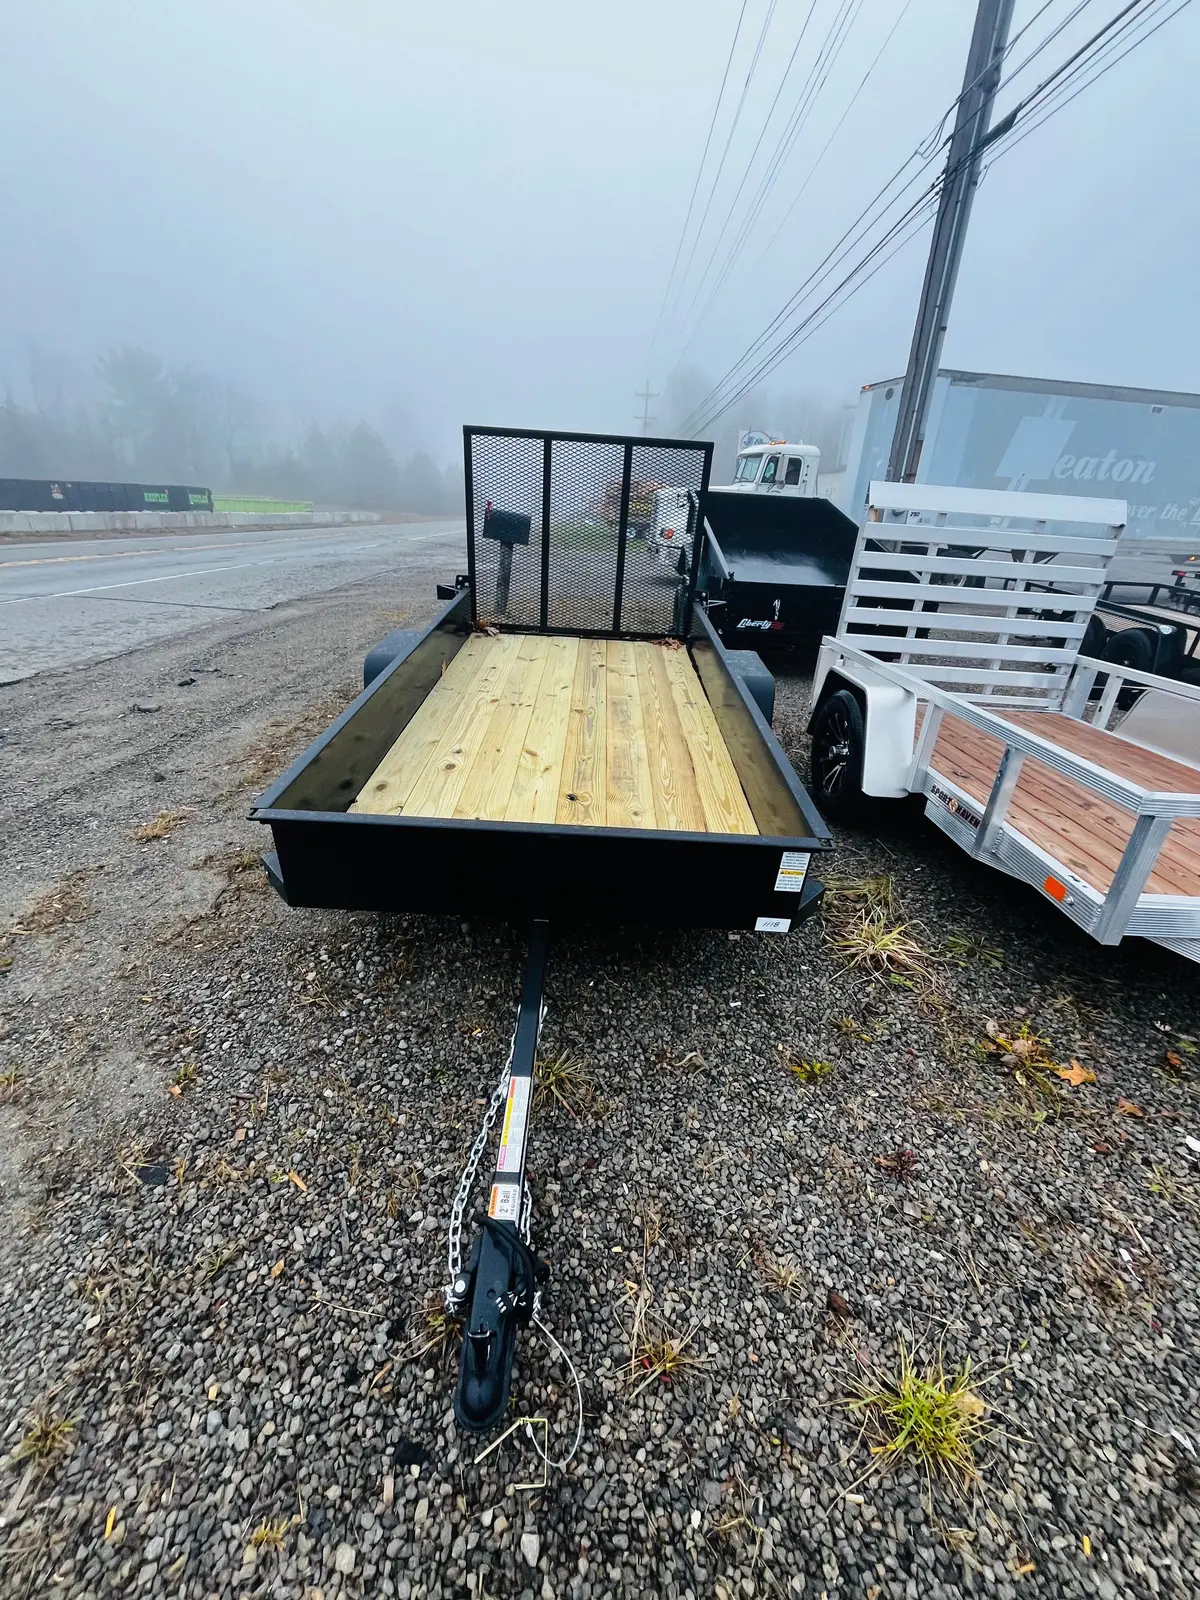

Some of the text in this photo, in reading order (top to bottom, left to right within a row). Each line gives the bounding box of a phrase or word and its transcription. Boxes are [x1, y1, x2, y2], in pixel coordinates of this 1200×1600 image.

[736, 618, 773, 630] Liberty
[931, 784, 981, 828] SPORT HAVEN
[500, 1190, 511, 1204] Ball
